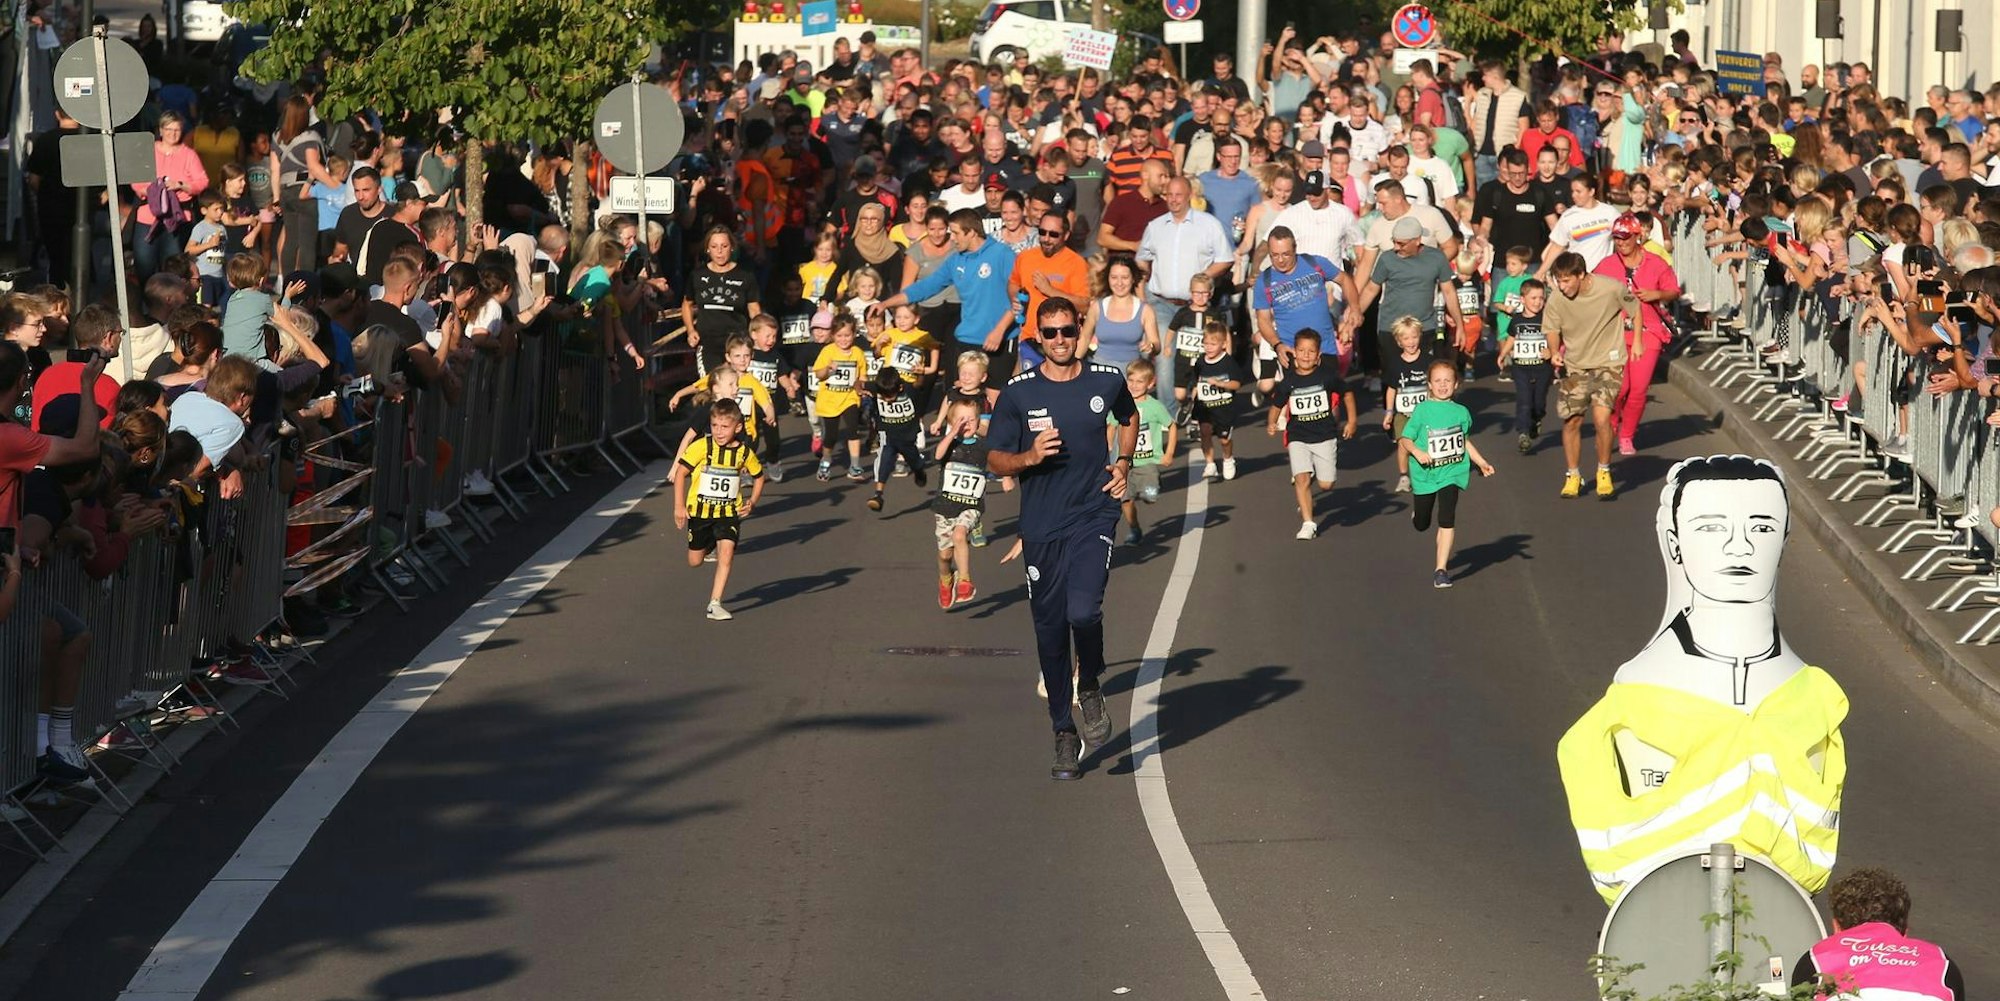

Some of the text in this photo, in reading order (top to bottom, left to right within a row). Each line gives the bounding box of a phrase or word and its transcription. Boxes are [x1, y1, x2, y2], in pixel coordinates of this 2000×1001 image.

[900, 351, 915, 365] 62
[835, 369, 850, 380] 59
[879, 400, 912, 414] 1305
[1295, 394, 1322, 410] 678
[1429, 434, 1464, 453] 1216
[710, 477, 730, 492] 56
[951, 473, 980, 491] 757
[1840, 937, 1920, 957] Tussi
[1849, 951, 1919, 967] on Tour
